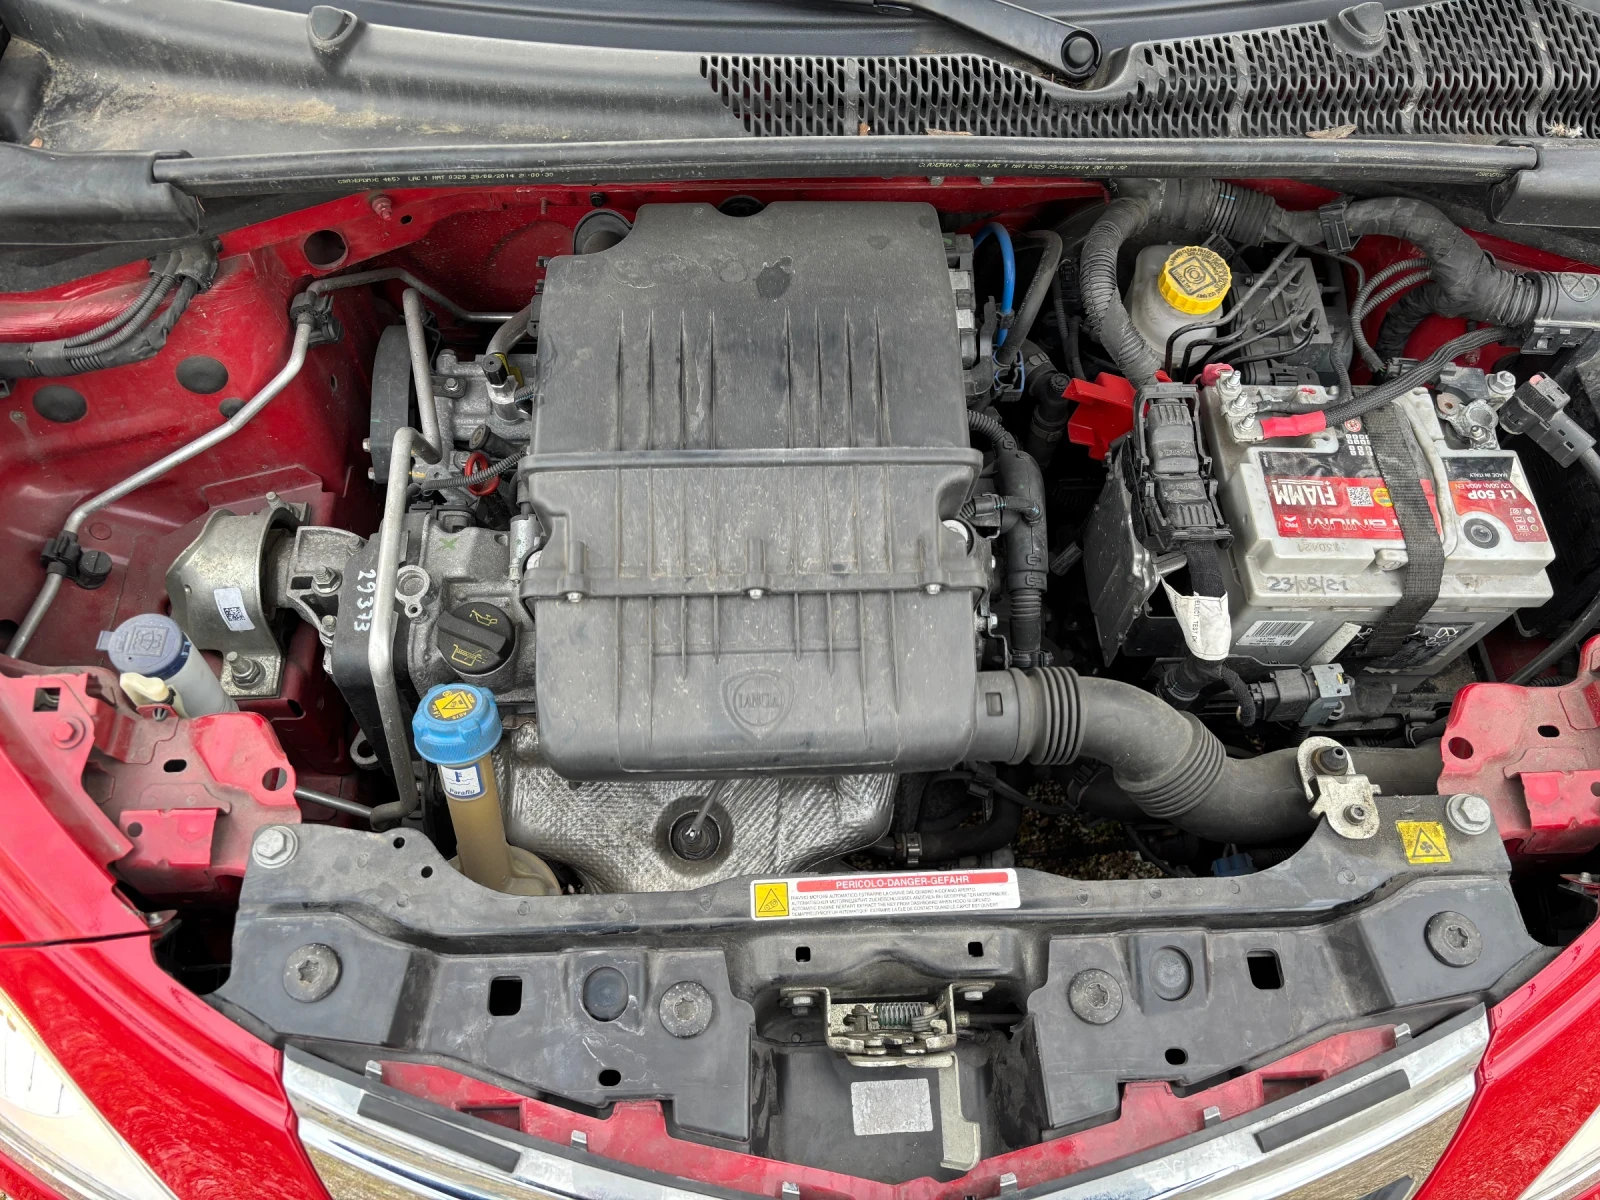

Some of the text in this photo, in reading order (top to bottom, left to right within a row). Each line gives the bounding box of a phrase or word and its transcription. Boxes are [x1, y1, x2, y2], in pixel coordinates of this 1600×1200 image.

[1272, 484, 1337, 506] FIAMM
[1468, 489, 1516, 500] L1 50P
[354, 569, 376, 632] 29373
[836, 875, 969, 889] PERICOLO-DANGER-GEFAHR
